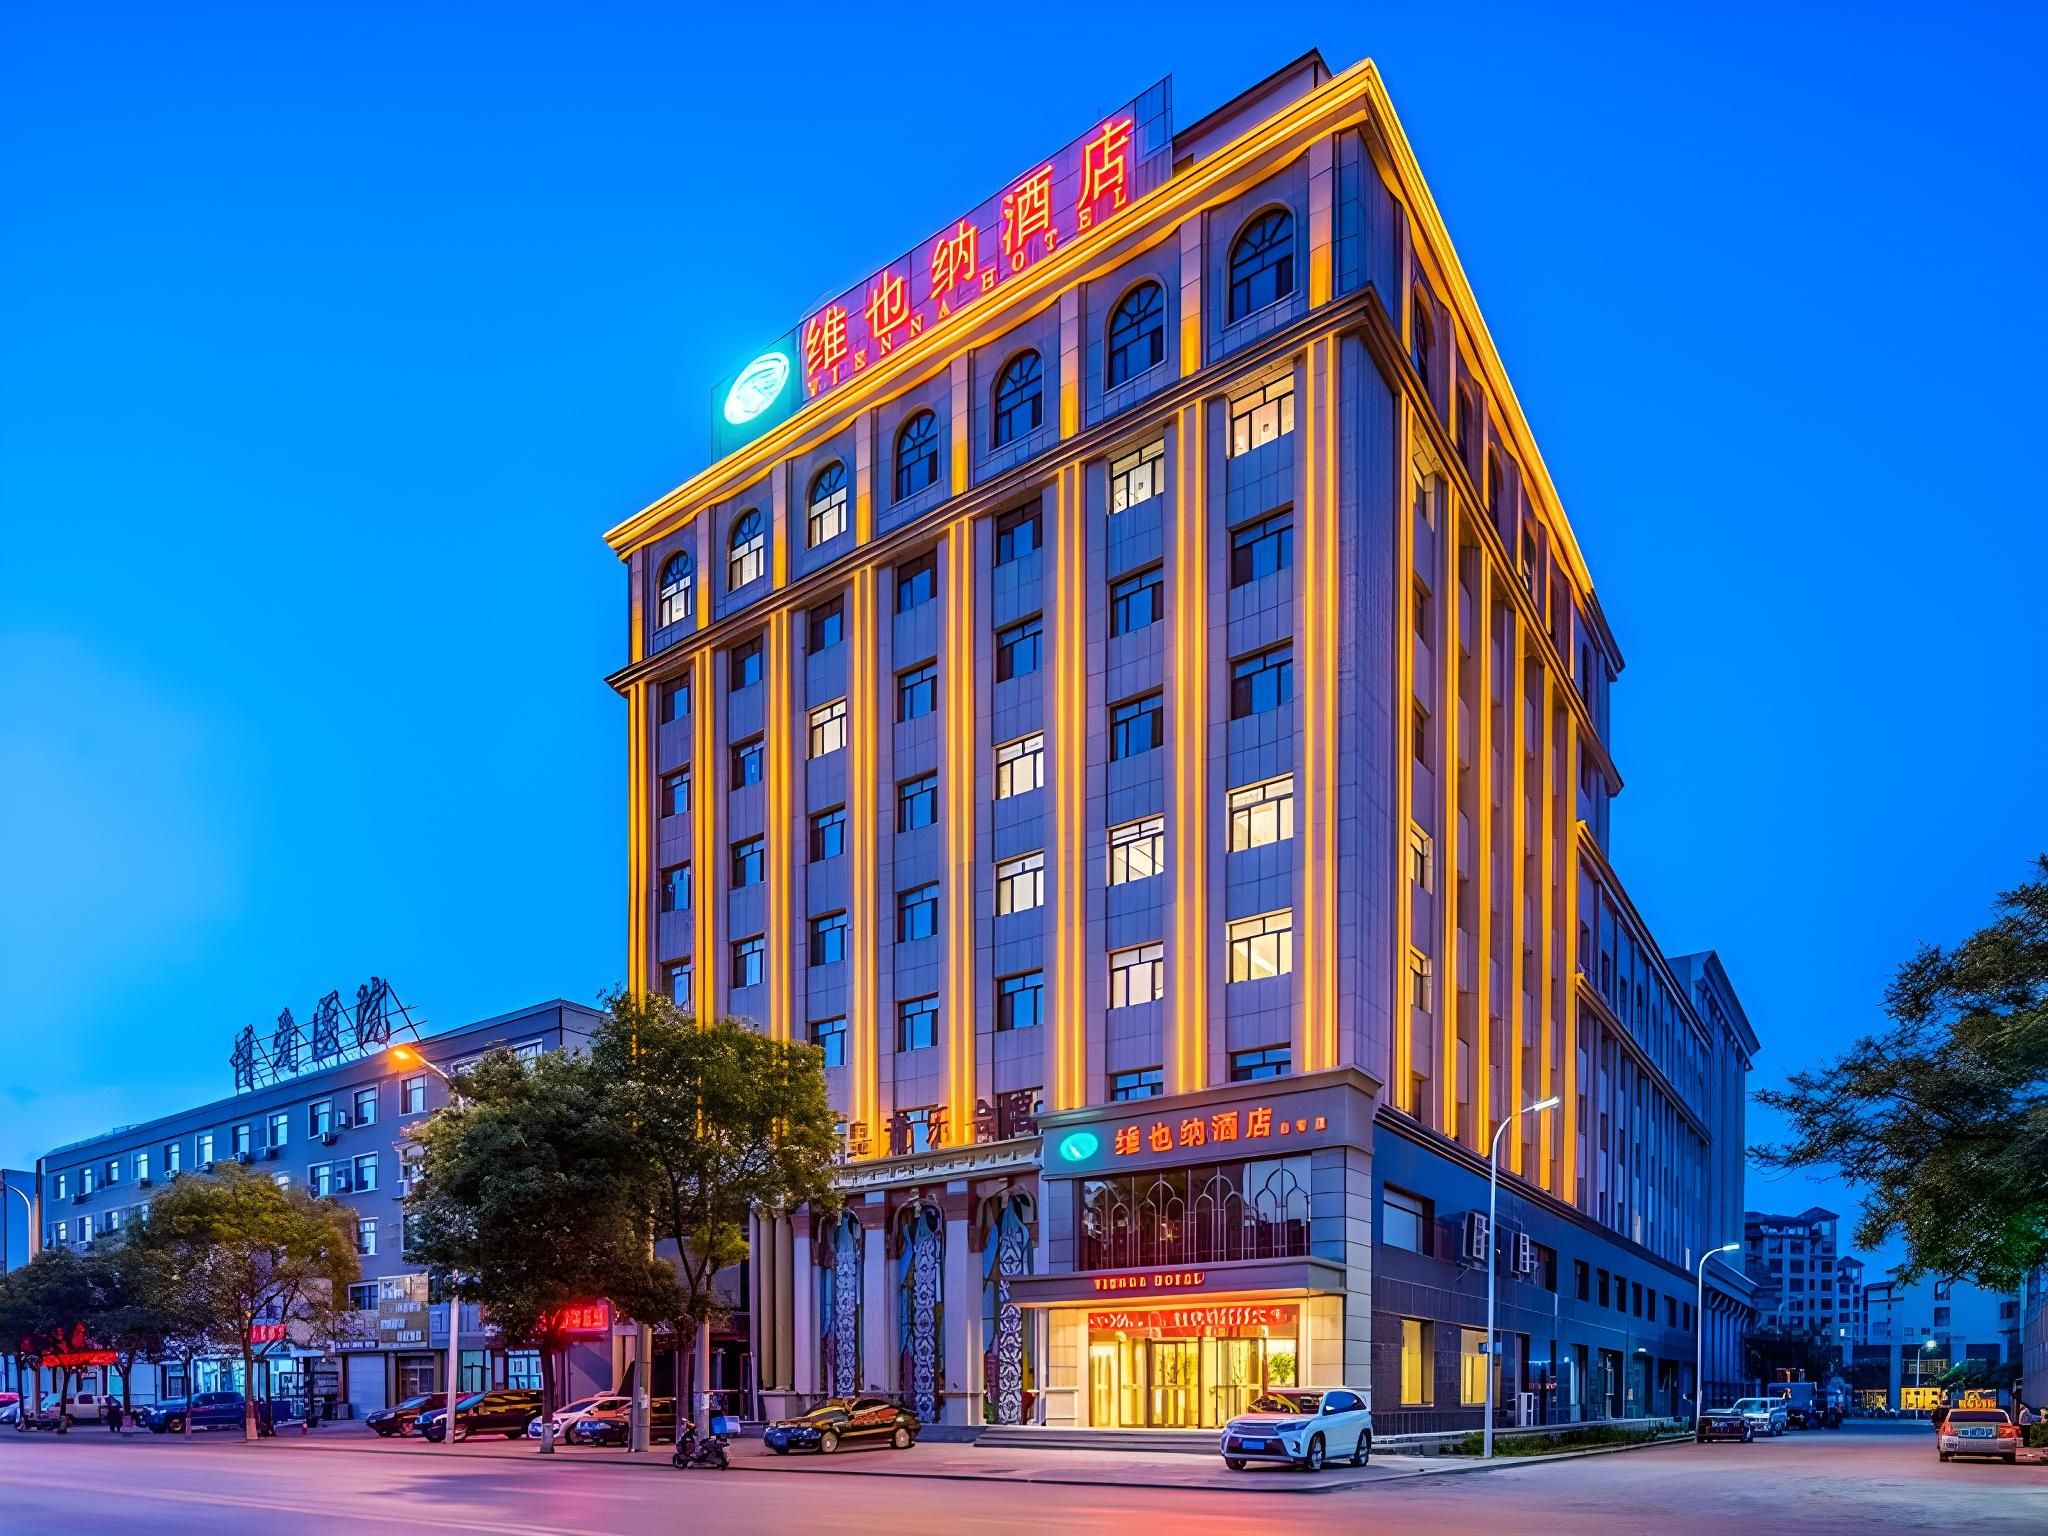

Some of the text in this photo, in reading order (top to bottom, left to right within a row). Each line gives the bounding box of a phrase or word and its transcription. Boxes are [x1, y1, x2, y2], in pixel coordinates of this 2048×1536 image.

[806, 119, 1132, 376] 维也纳酒店
